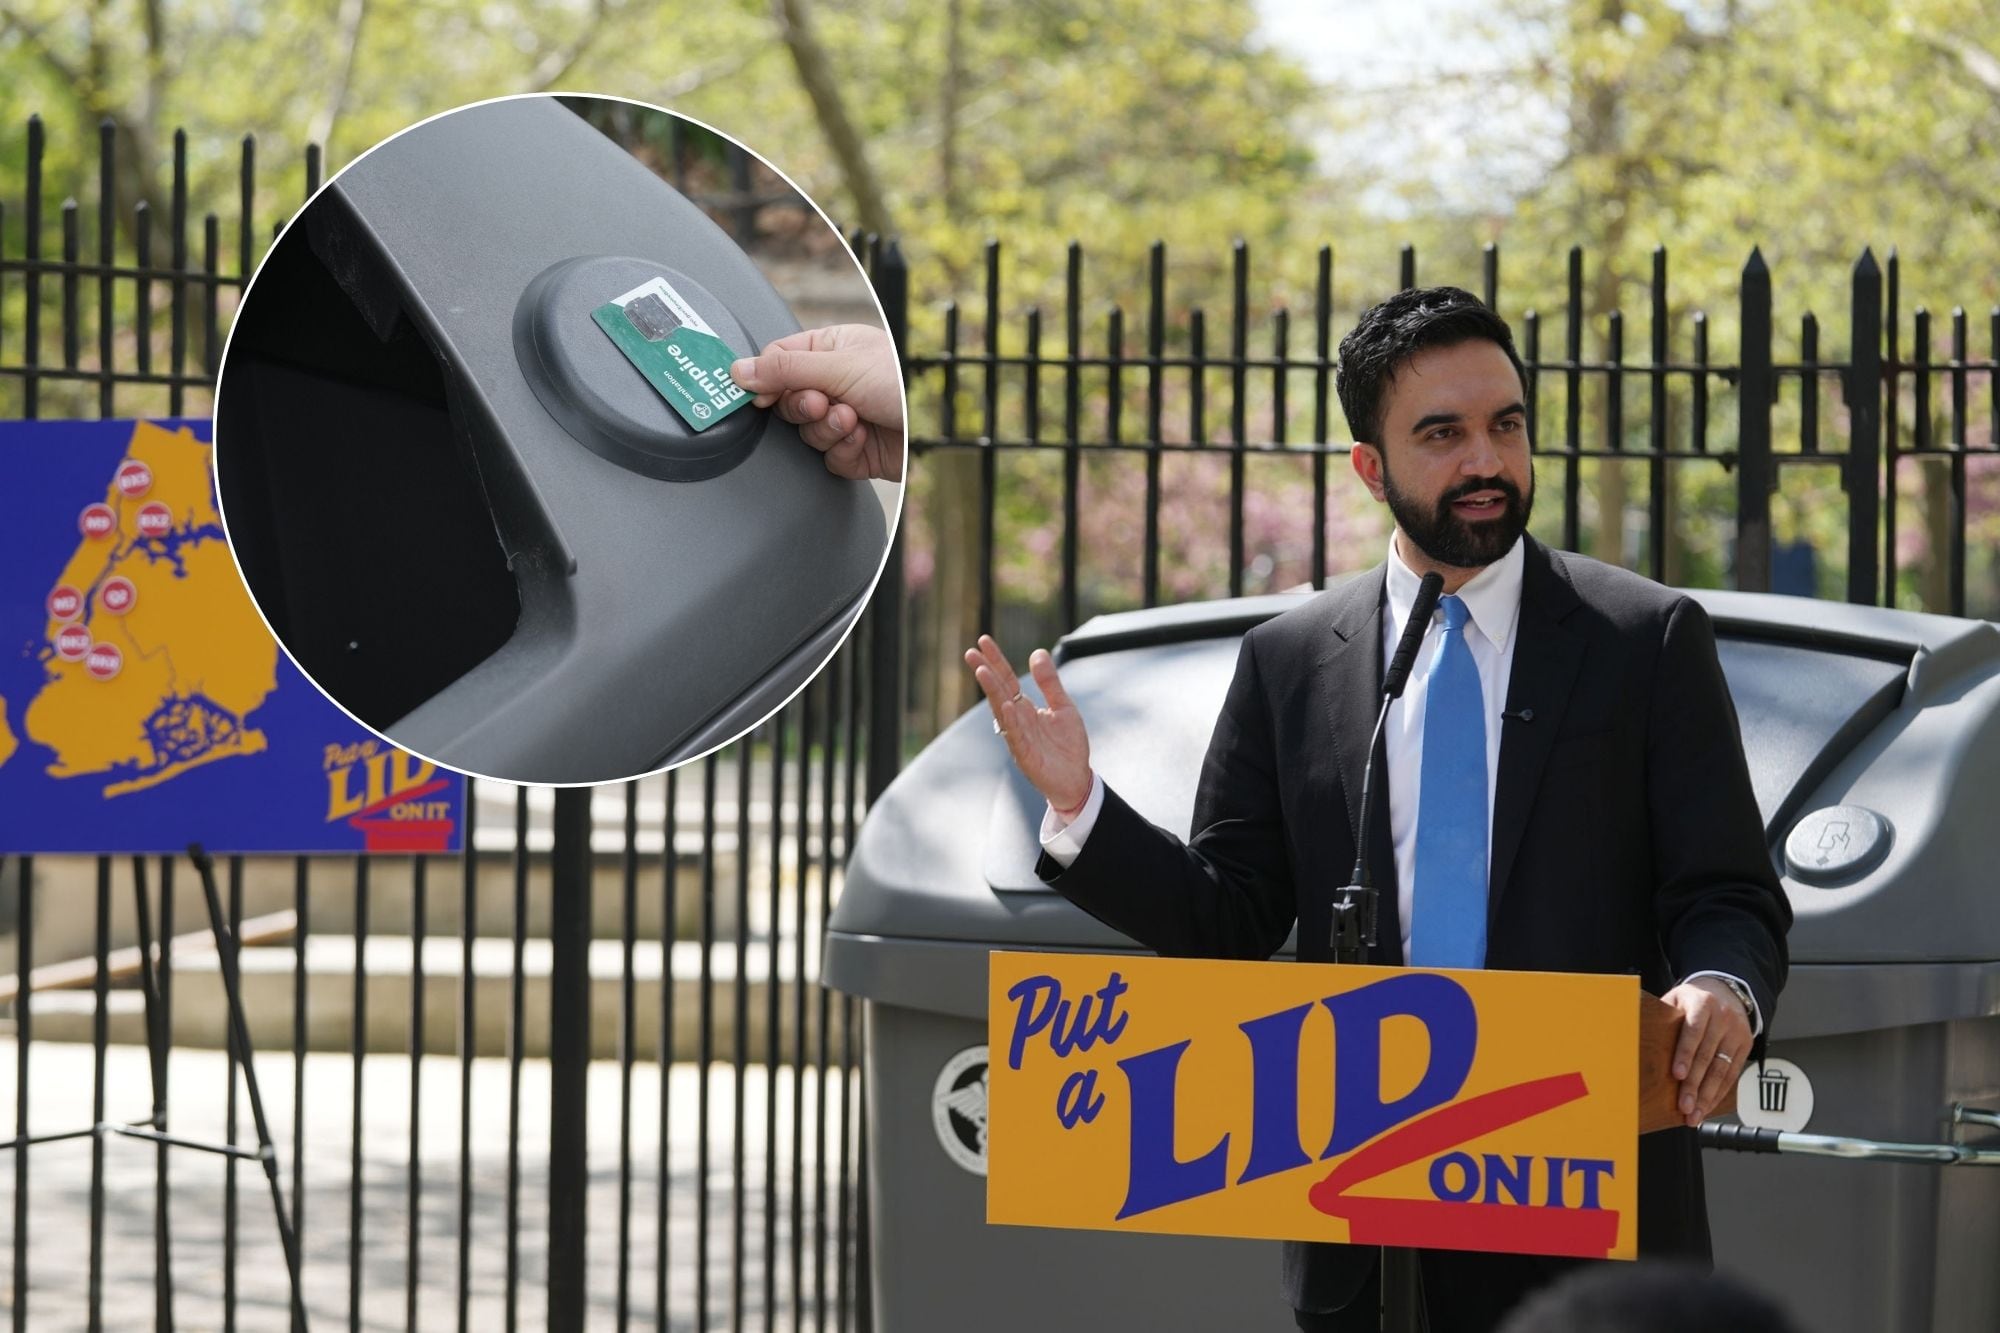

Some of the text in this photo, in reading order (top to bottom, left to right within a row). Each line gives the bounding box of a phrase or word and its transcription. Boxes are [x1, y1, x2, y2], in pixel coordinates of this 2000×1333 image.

[663, 370, 695, 403] sanitation
[667, 344, 731, 411] Empire
[325, 748, 436, 822] LID
[389, 802, 451, 820] ON IT
[1007, 972, 1129, 1070] Put
[1056, 1069, 1105, 1130] a
[1115, 973, 1478, 1221] LID
[1429, 1151, 1615, 1210] ON IT
